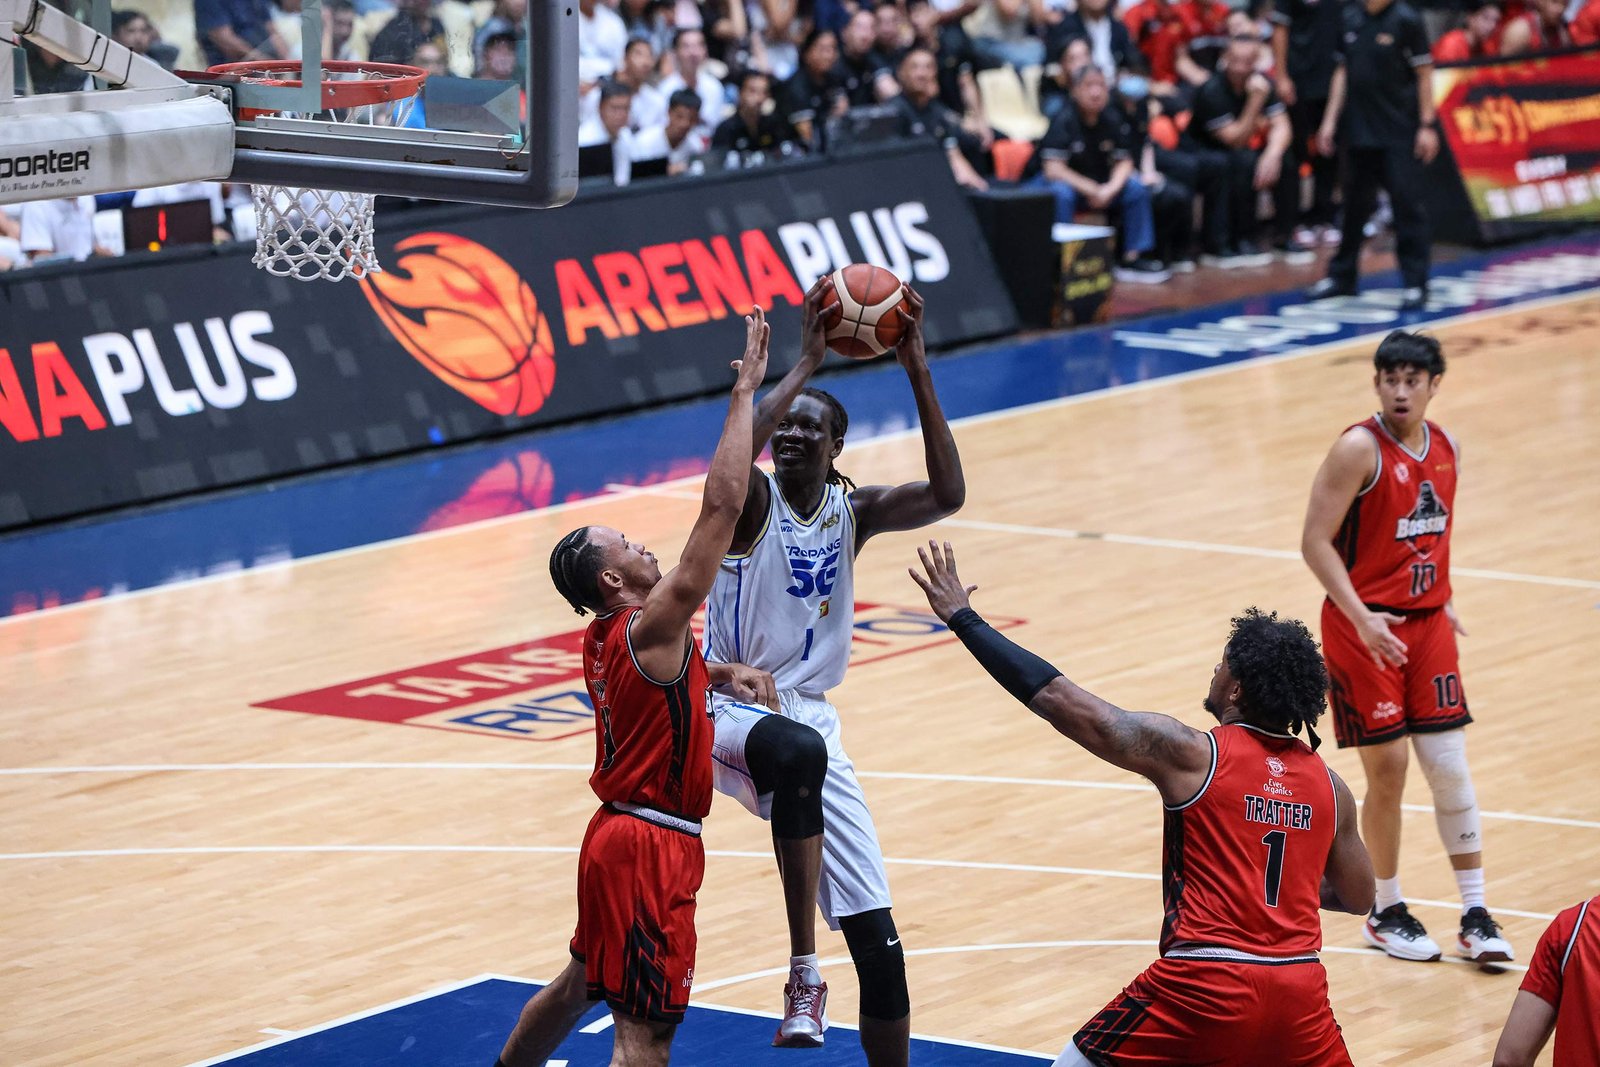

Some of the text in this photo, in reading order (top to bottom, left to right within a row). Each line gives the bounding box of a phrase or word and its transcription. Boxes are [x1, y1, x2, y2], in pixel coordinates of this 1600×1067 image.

[786, 551, 840, 598] 5G
[1409, 562, 1436, 597] 10
[801, 628, 814, 661] 1
[1431, 671, 1461, 712] 10
[1263, 783, 1293, 796] Organics
[1268, 778, 1283, 789] Ever
[1244, 794, 1312, 831] TRATTER
[1261, 829, 1287, 908] 1
